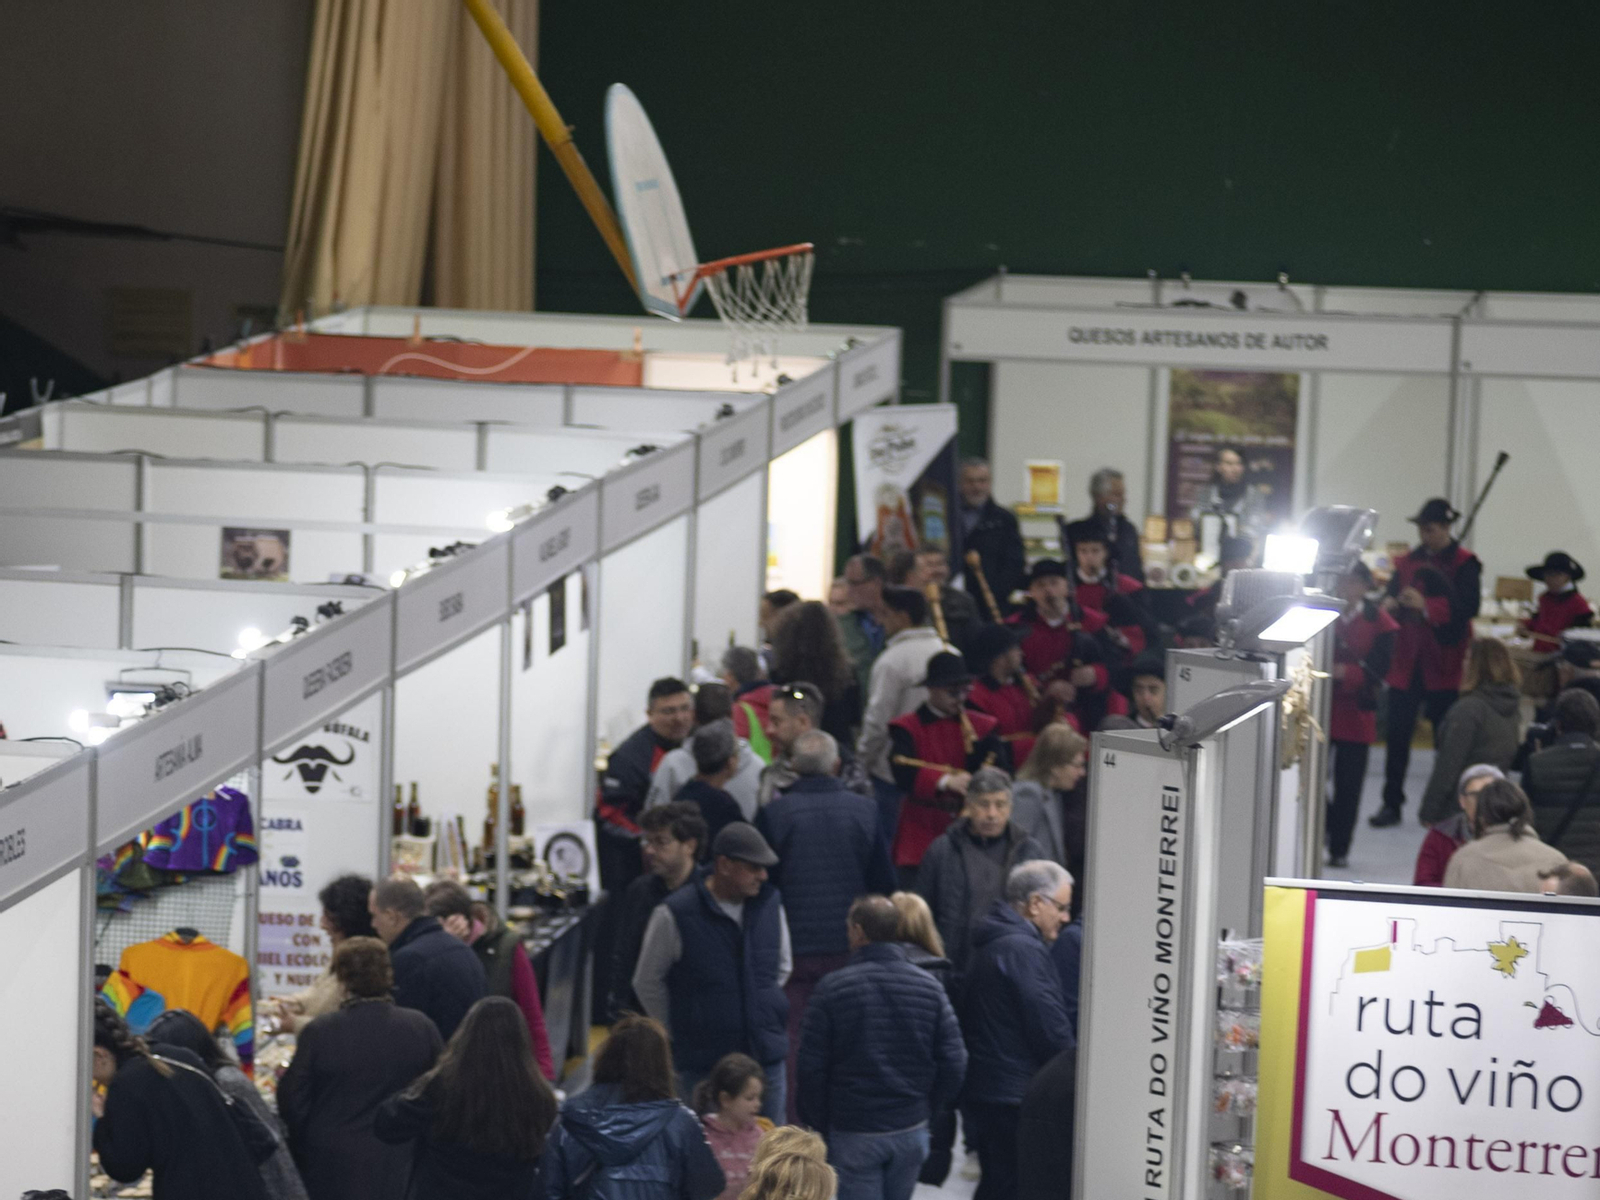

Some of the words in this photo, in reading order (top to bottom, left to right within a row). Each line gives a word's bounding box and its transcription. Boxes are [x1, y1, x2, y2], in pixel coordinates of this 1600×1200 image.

[1068, 326, 1136, 345] QUESOS
[1141, 329, 1240, 349] ARTESANOS
[1244, 331, 1267, 350] DE
[1271, 332, 1329, 351] AUTOR
[1179, 667, 1192, 682] 45
[1103, 752, 1117, 768] 44
[1154, 784, 1181, 965] MONTERREI
[1148, 973, 1172, 1044] VIÑO
[1356, 990, 1482, 1040] ruta
[1149, 1053, 1169, 1097] DO
[1345, 1049, 1426, 1103] do
[1447, 1056, 1583, 1113] viño
[1145, 1107, 1166, 1188] RUTA
